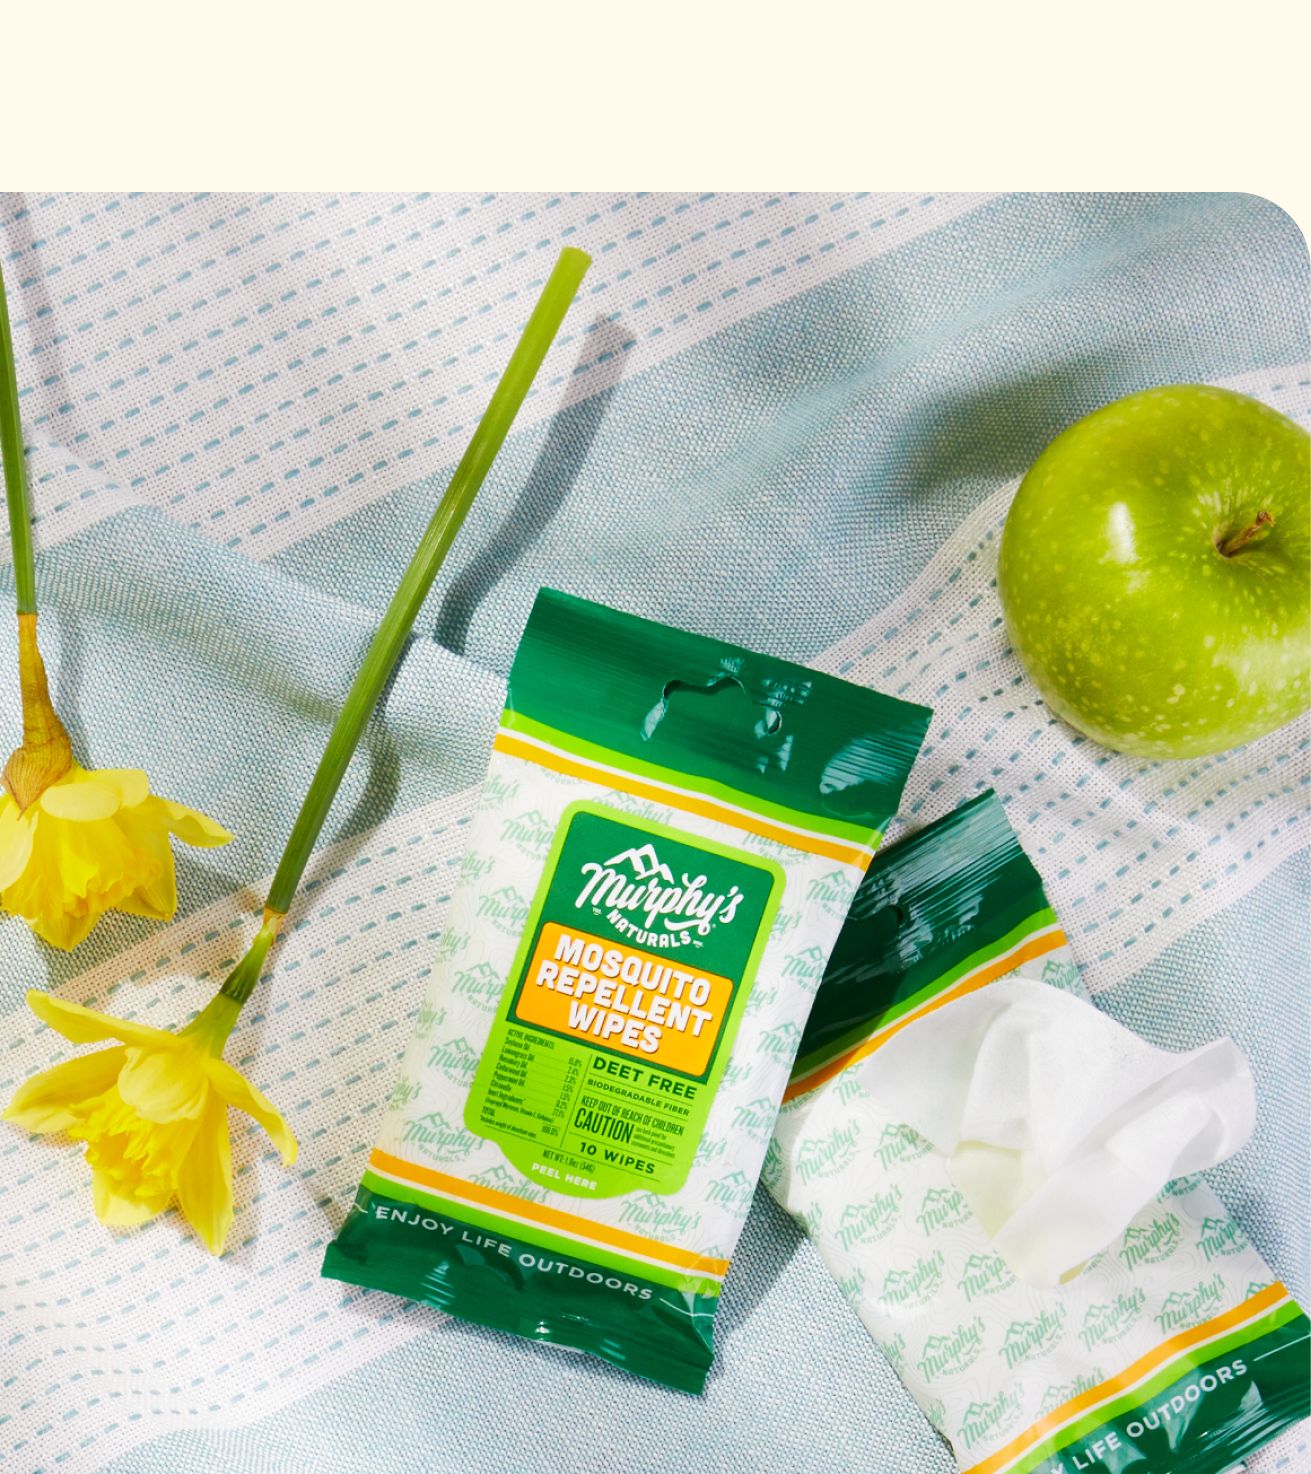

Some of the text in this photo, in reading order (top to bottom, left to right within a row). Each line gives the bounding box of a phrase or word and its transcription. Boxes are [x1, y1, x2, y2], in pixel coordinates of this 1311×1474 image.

[575, 863, 743, 935] Murphy's
[606, 909, 691, 948] NATURALS
[554, 934, 711, 1007] MOSQUITO
[536, 959, 713, 1037] REPELLENT
[568, 1001, 662, 1053] WIPES
[587, 1078, 690, 1116] BIODEGRADABLE FIBER
[592, 1056, 697, 1099] DEET FREE
[573, 1107, 634, 1143] CAUTION
[580, 1095, 684, 1136] KEEP OUT OF REACH OF CHILDREN
[531, 1162, 597, 1190] PEEL HERE
[579, 1141, 655, 1174] 10 WIPES
[375, 1206, 653, 1300] ENJOY LIFE OUTDOORS
[1072, 1431, 1121, 1470] LIFE
[1127, 1359, 1247, 1438] OUTDOORS
